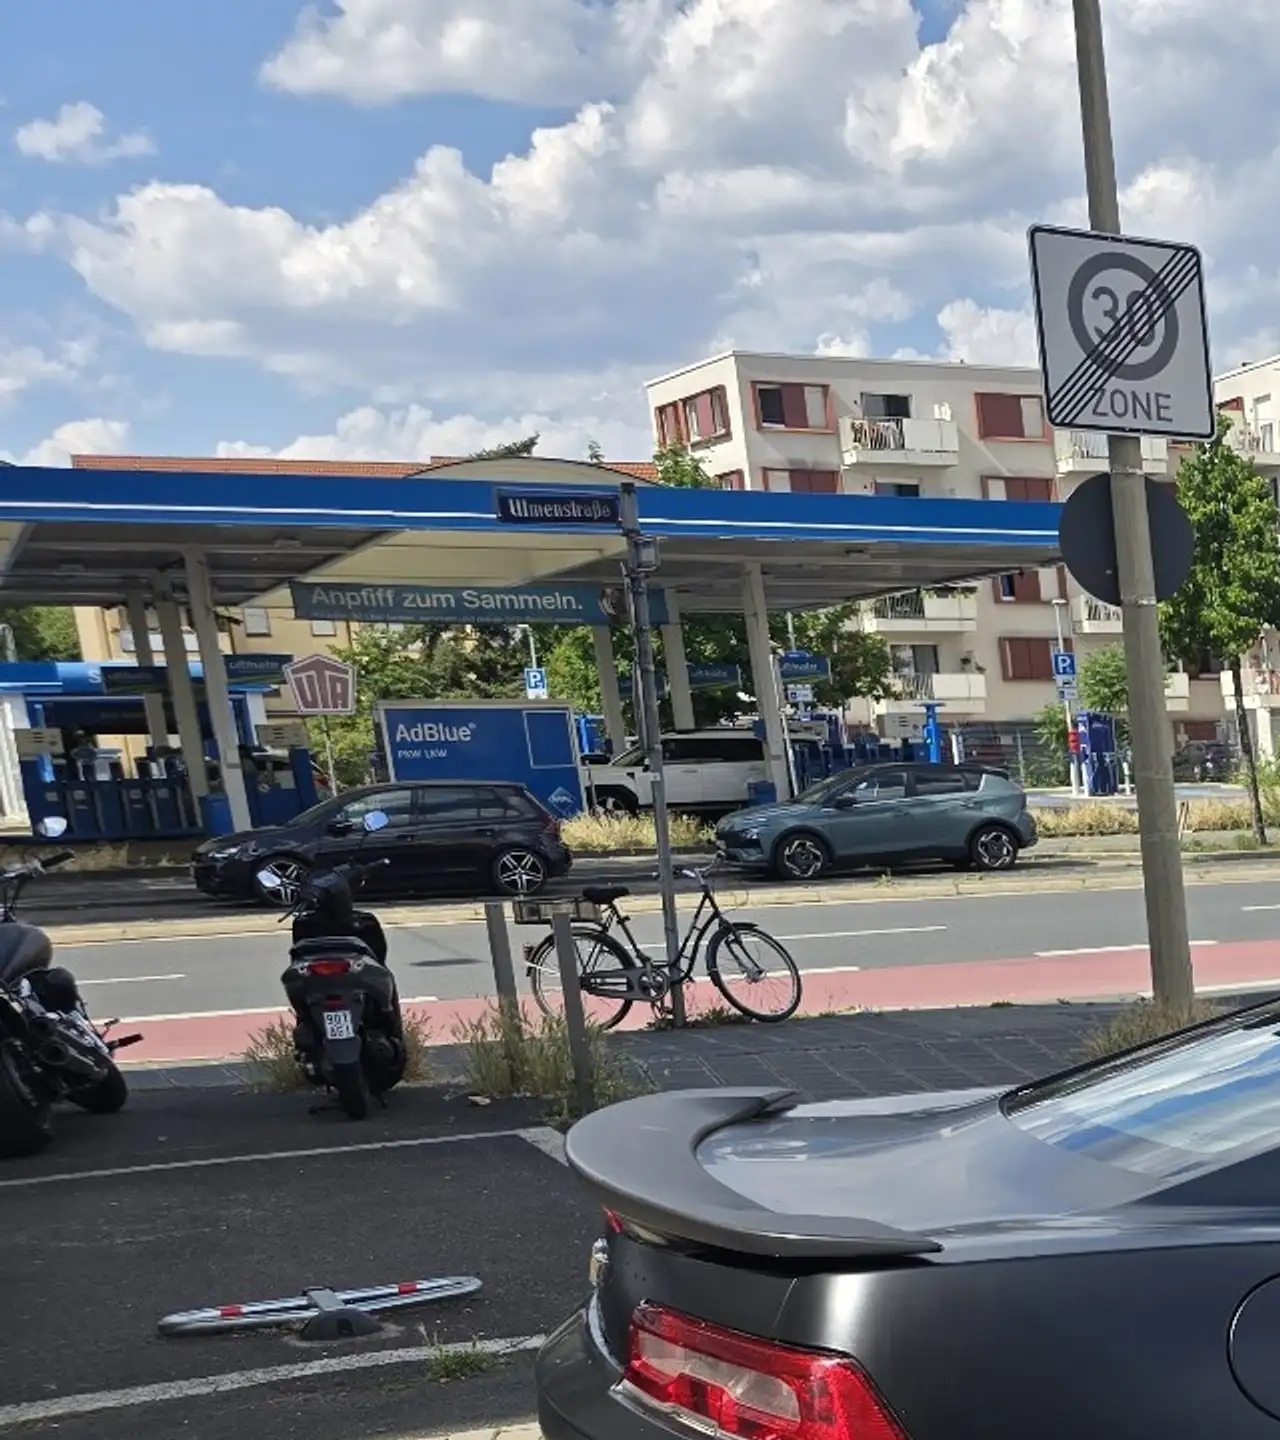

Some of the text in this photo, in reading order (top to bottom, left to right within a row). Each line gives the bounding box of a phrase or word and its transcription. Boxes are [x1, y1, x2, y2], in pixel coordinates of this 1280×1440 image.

[1091, 285, 1156, 347] 30
[1091, 387, 1174, 422] ZONE
[508, 498, 612, 520] Ulmenstraße
[311, 586, 584, 610] Anpfiff zum Sammeln.
[1058, 656, 1072, 673] P
[288, 657, 354, 711] UTA
[528, 672, 541, 688] P
